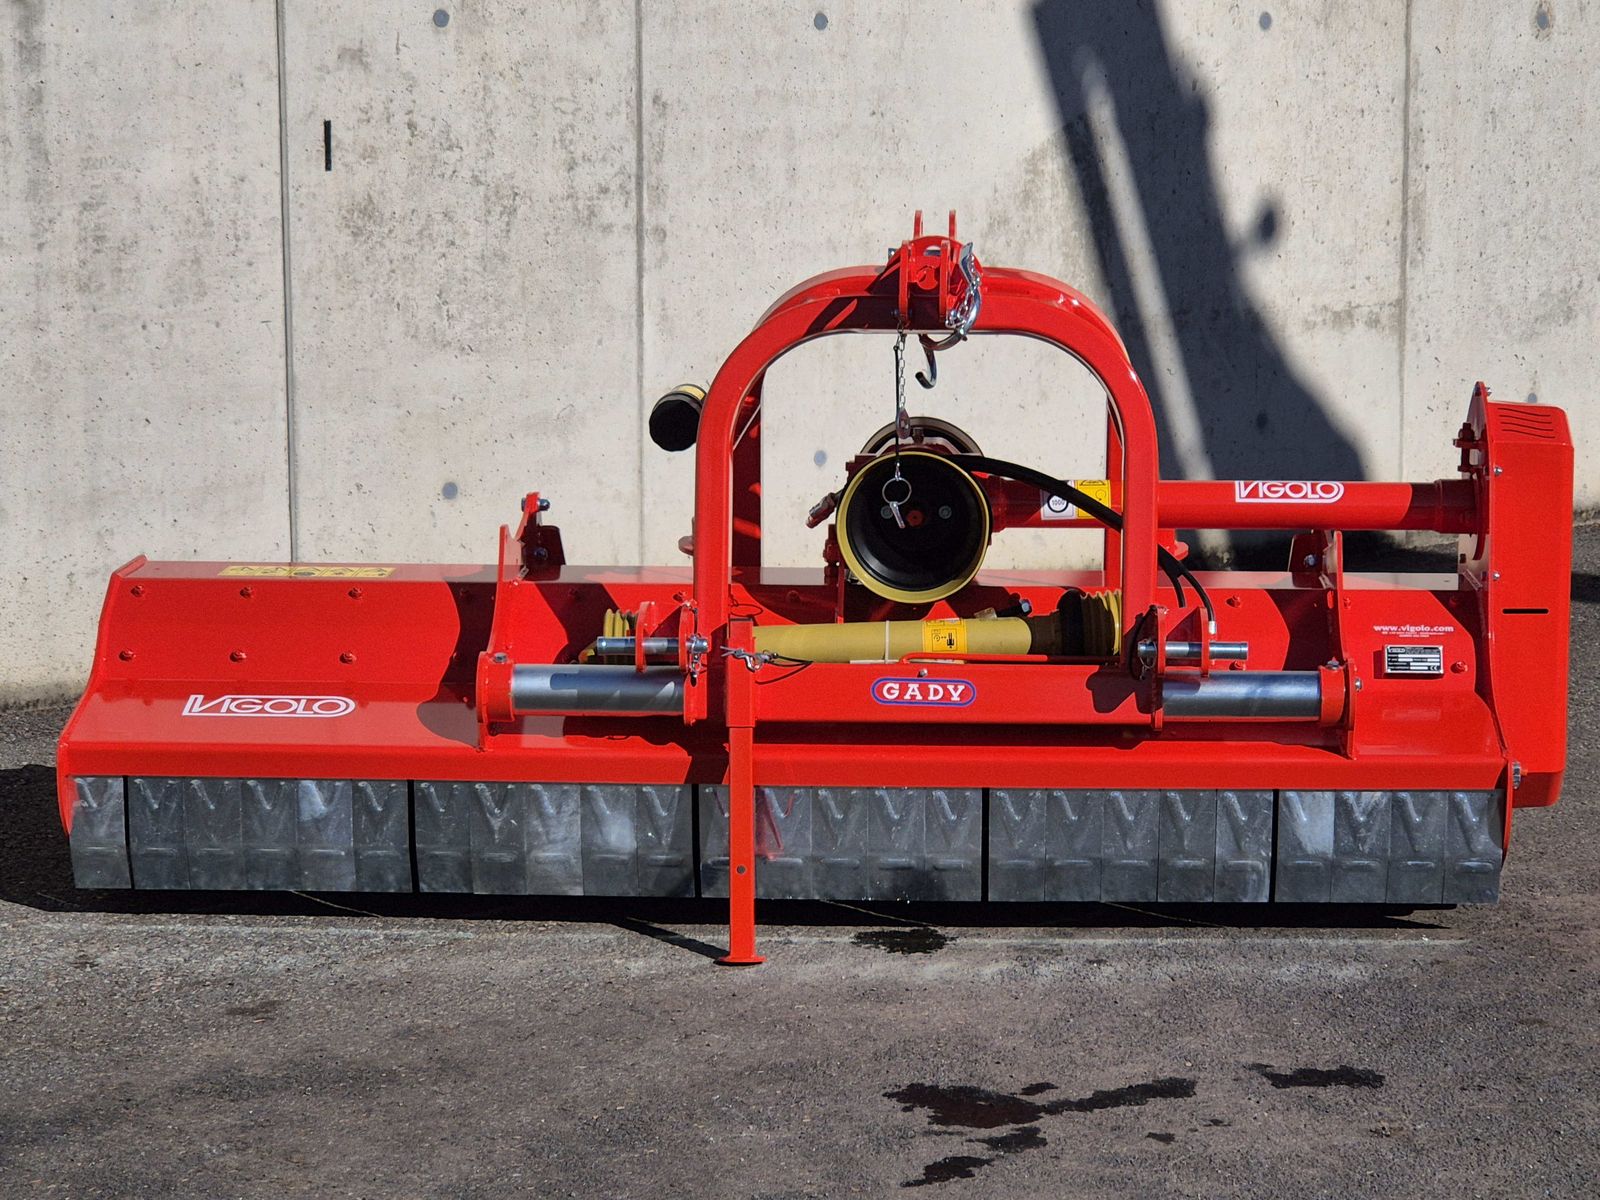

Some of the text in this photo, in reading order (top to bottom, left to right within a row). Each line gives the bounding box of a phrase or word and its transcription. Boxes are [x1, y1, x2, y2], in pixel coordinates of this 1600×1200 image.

[1235, 480, 1344, 503] VIGOLO
[1373, 624, 1454, 633] www.vigolo.com
[882, 682, 965, 701] GADY
[182, 694, 356, 718] VIGOLO
